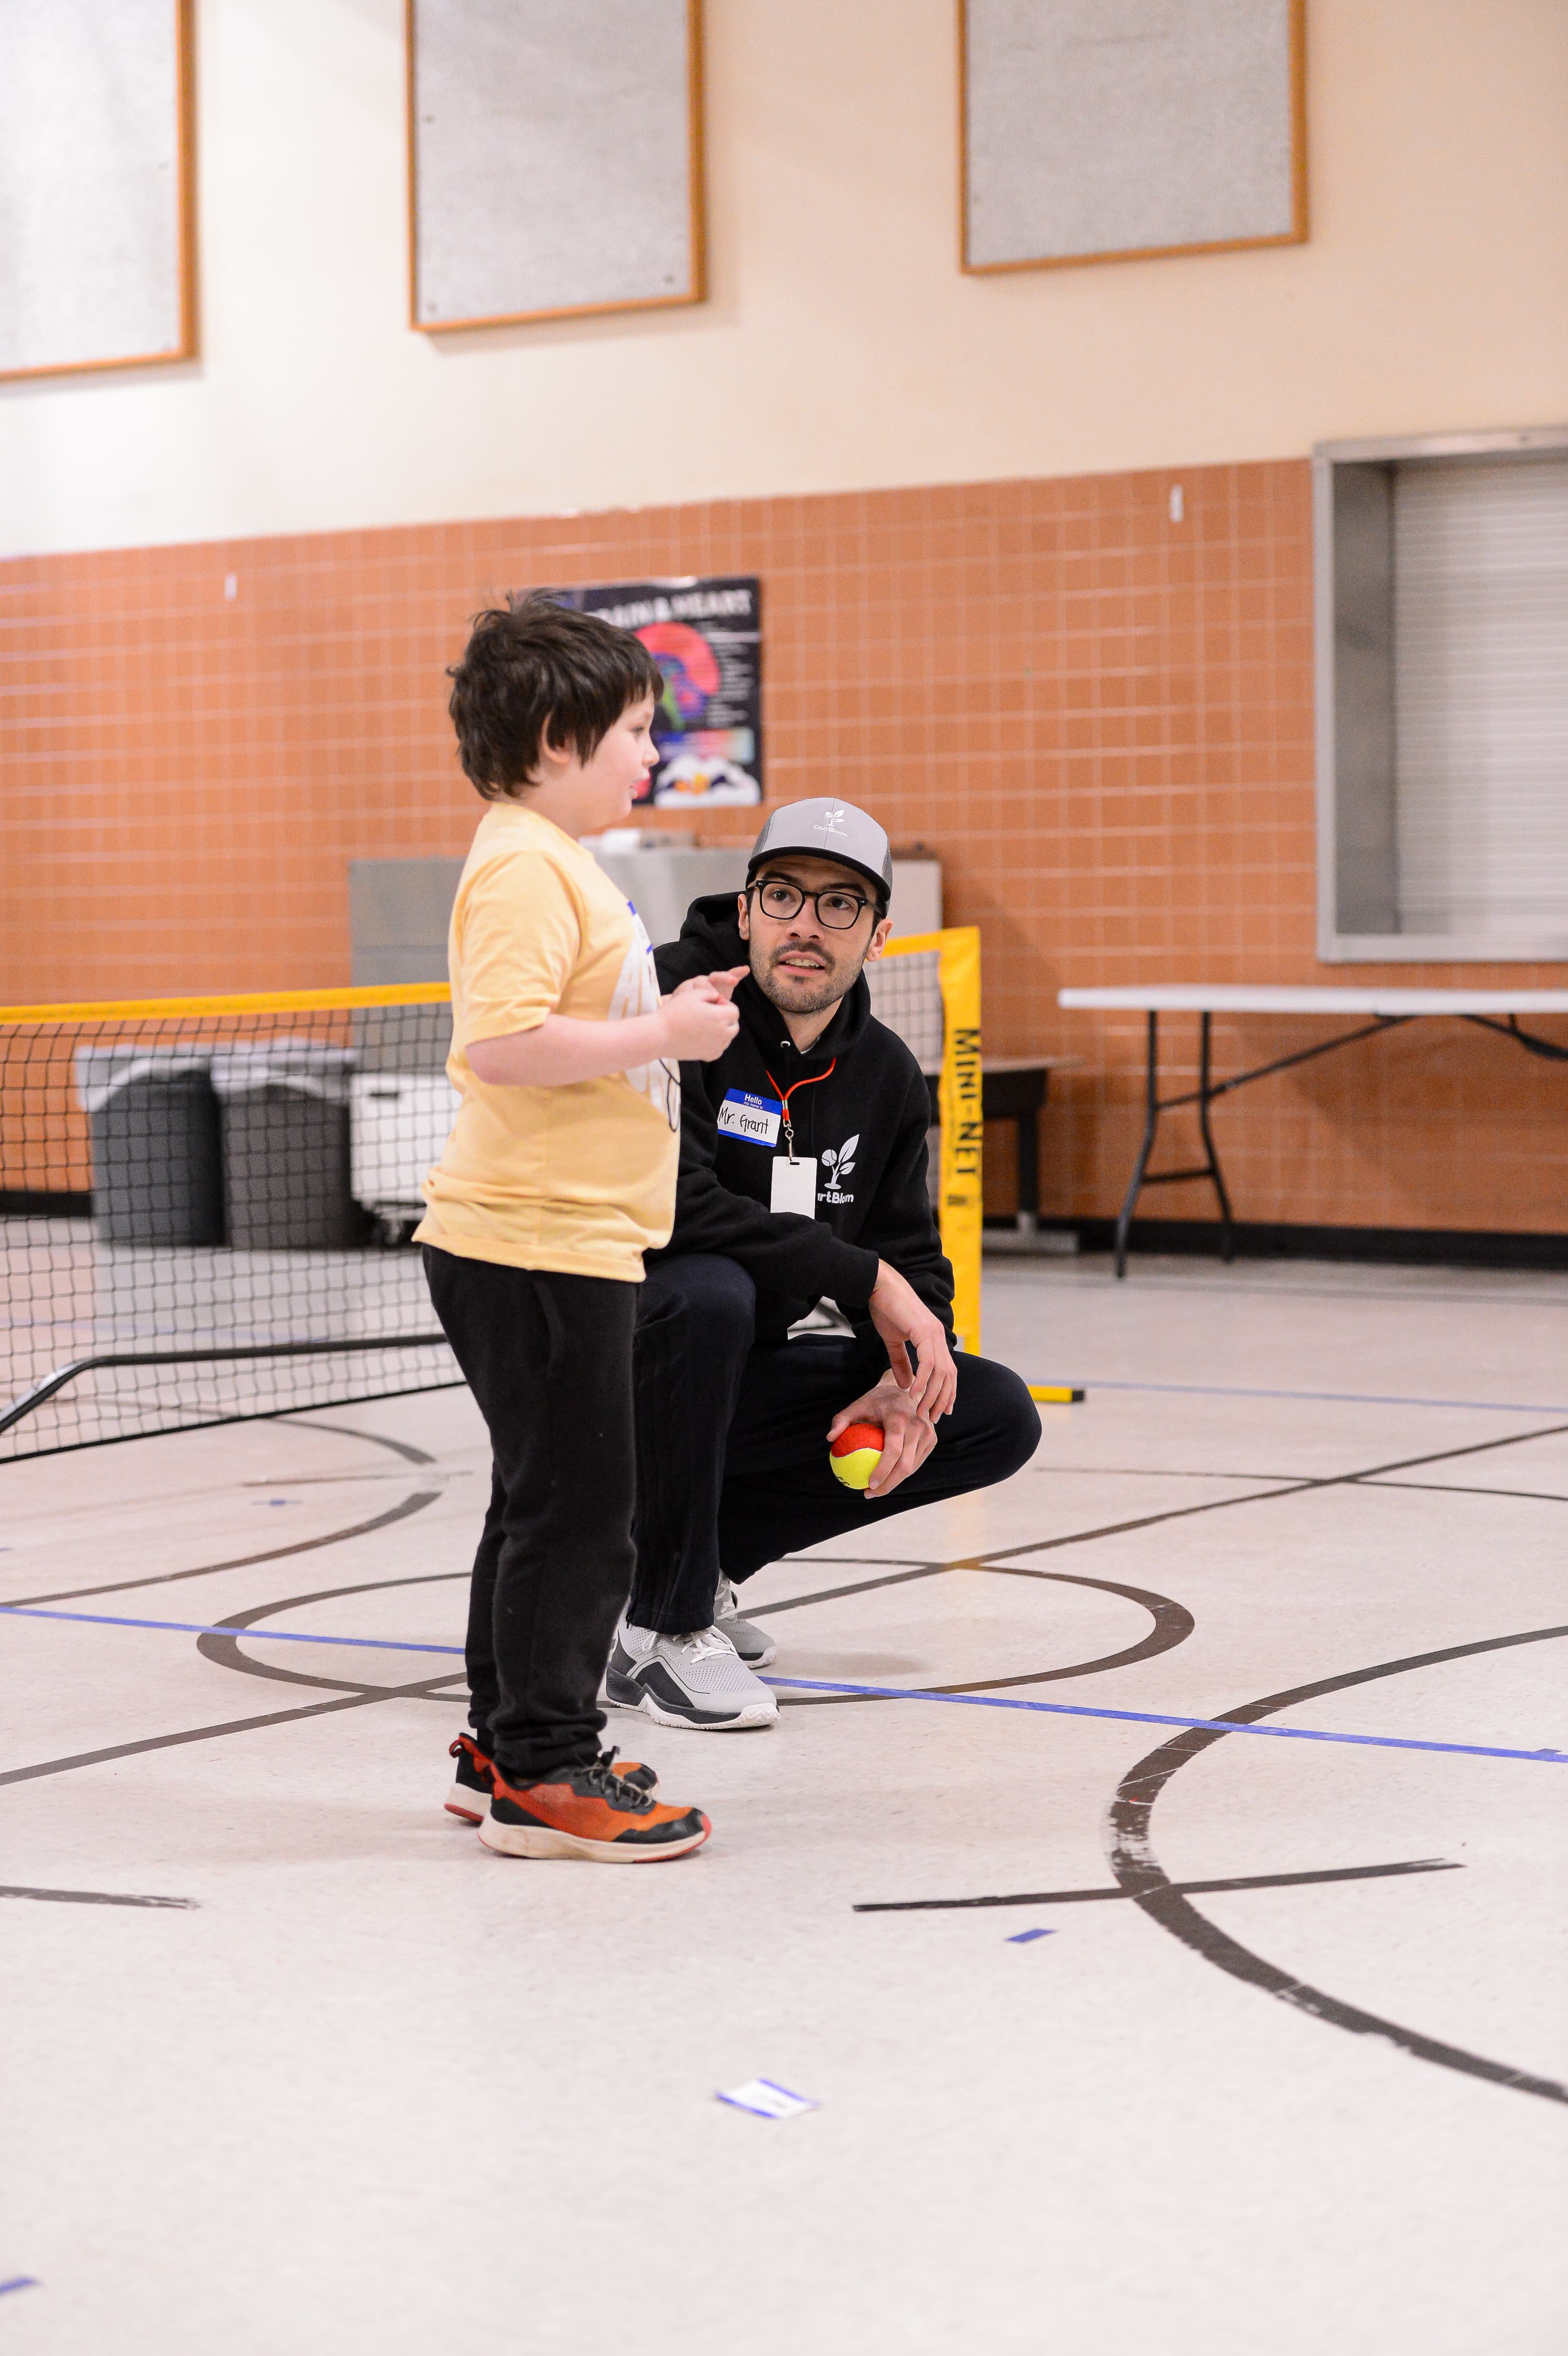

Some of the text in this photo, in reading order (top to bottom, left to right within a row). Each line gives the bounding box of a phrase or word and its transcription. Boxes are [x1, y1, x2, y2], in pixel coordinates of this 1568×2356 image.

[671, 589, 752, 619] HEART
[813, 824, 848, 838] CourtBloom
[744, 1094, 762, 1105] Hello
[719, 1106, 769, 1134] Mr. Grant
